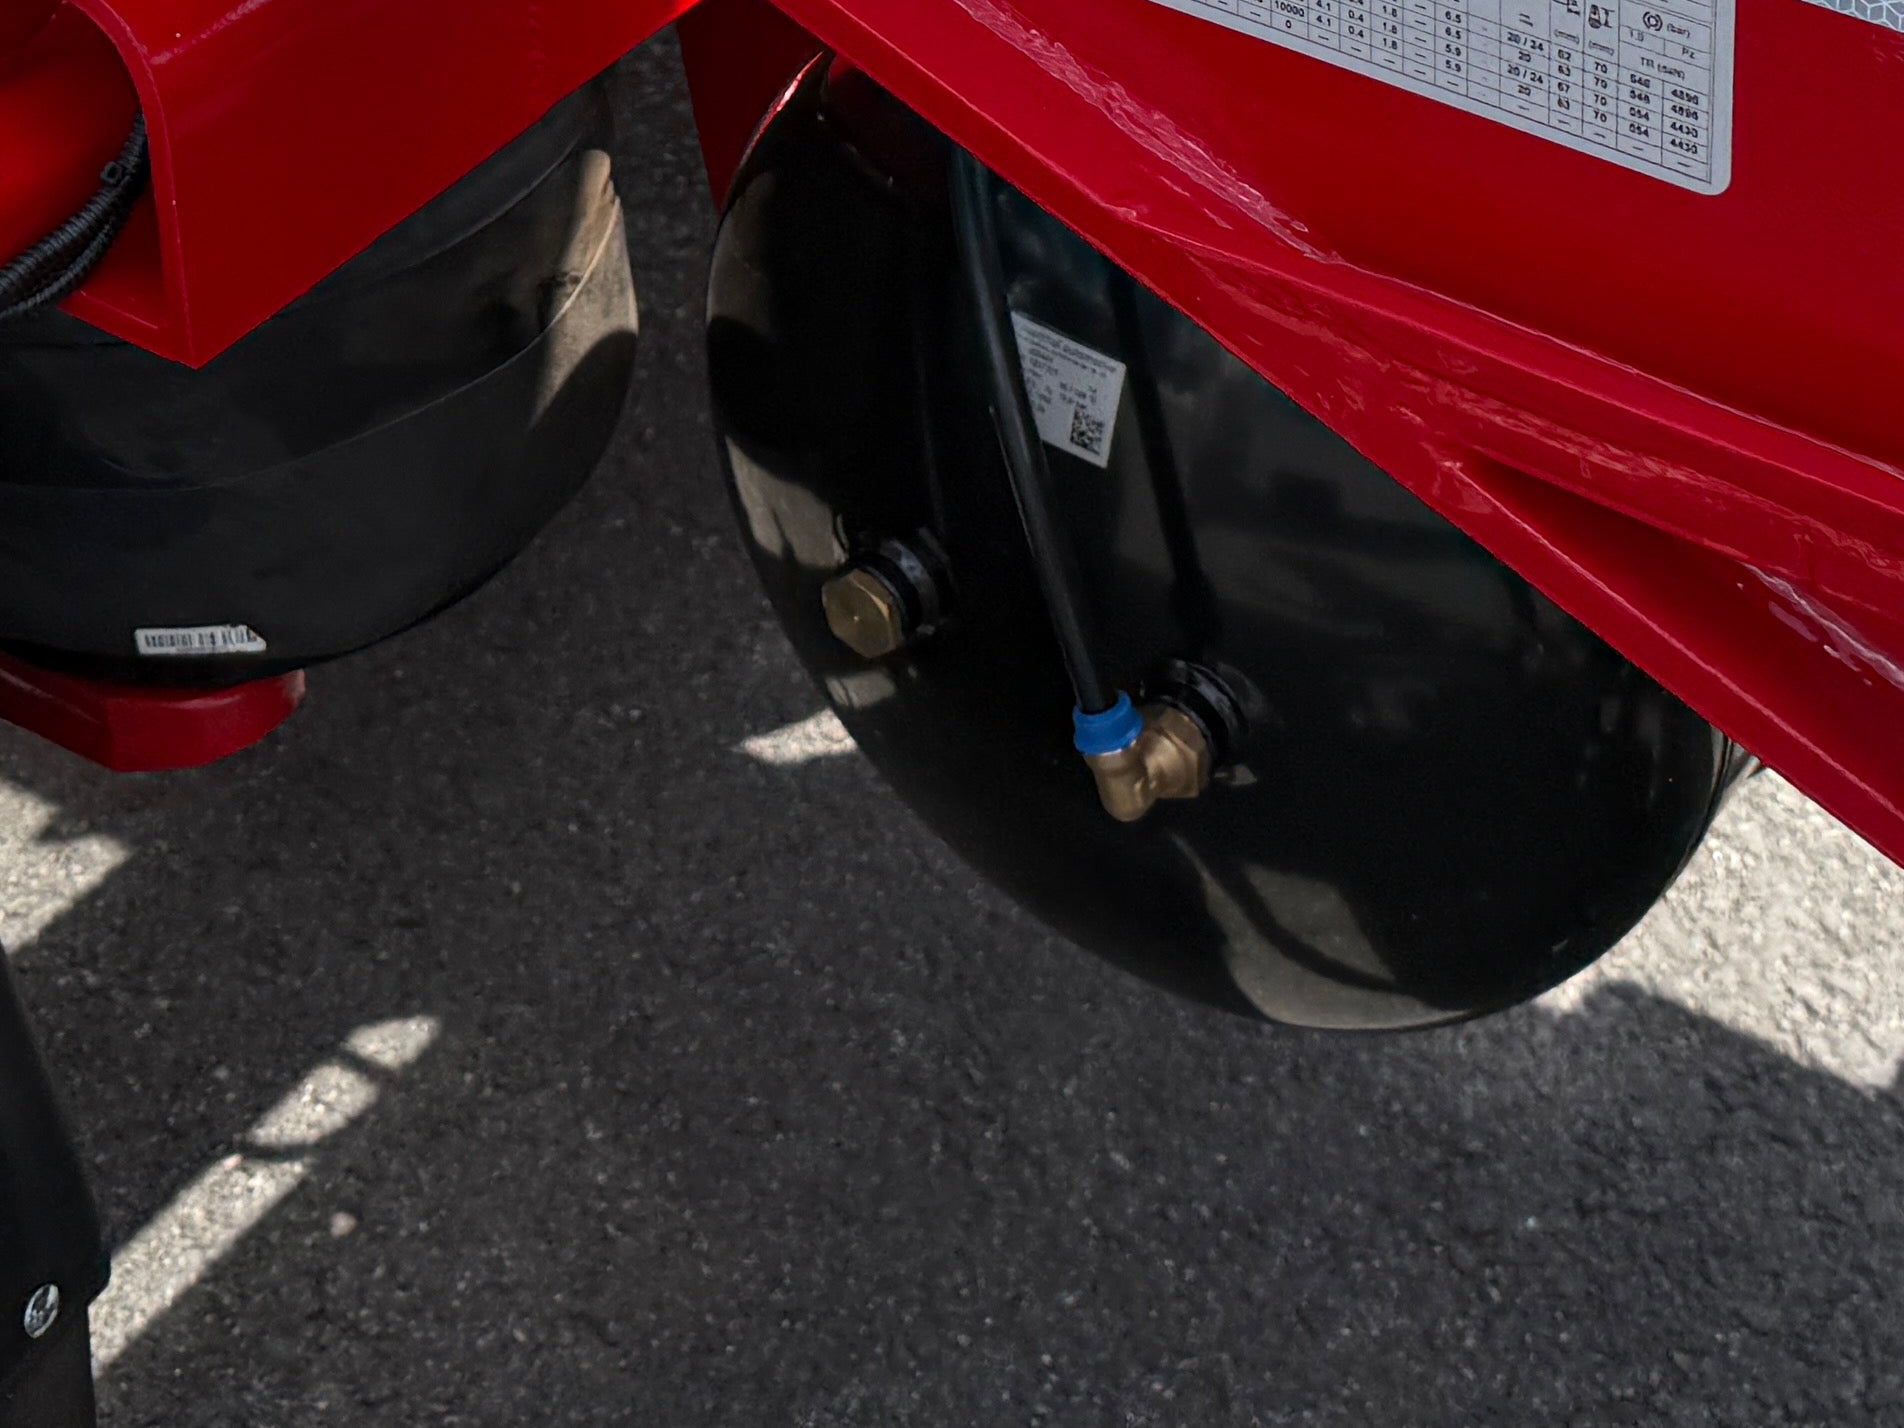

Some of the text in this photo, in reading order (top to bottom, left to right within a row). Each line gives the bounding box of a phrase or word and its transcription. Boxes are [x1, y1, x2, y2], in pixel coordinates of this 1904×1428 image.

[1275, 0, 1305, 18] 10000
[1316, 0, 1331, 11] 4.1
[1316, 14, 1331, 27] 4.1
[1348, 9, 1364, 22] 0.4
[1348, 25, 1364, 39] 0.4
[1445, 44, 1462, 57] 5.9
[1445, 60, 1462, 73] 5.9
[1594, 61, 1608, 74] 70
[1594, 77, 1608, 89] 70
[1594, 94, 1607, 106] 70
[1594, 111, 1607, 123] 70
